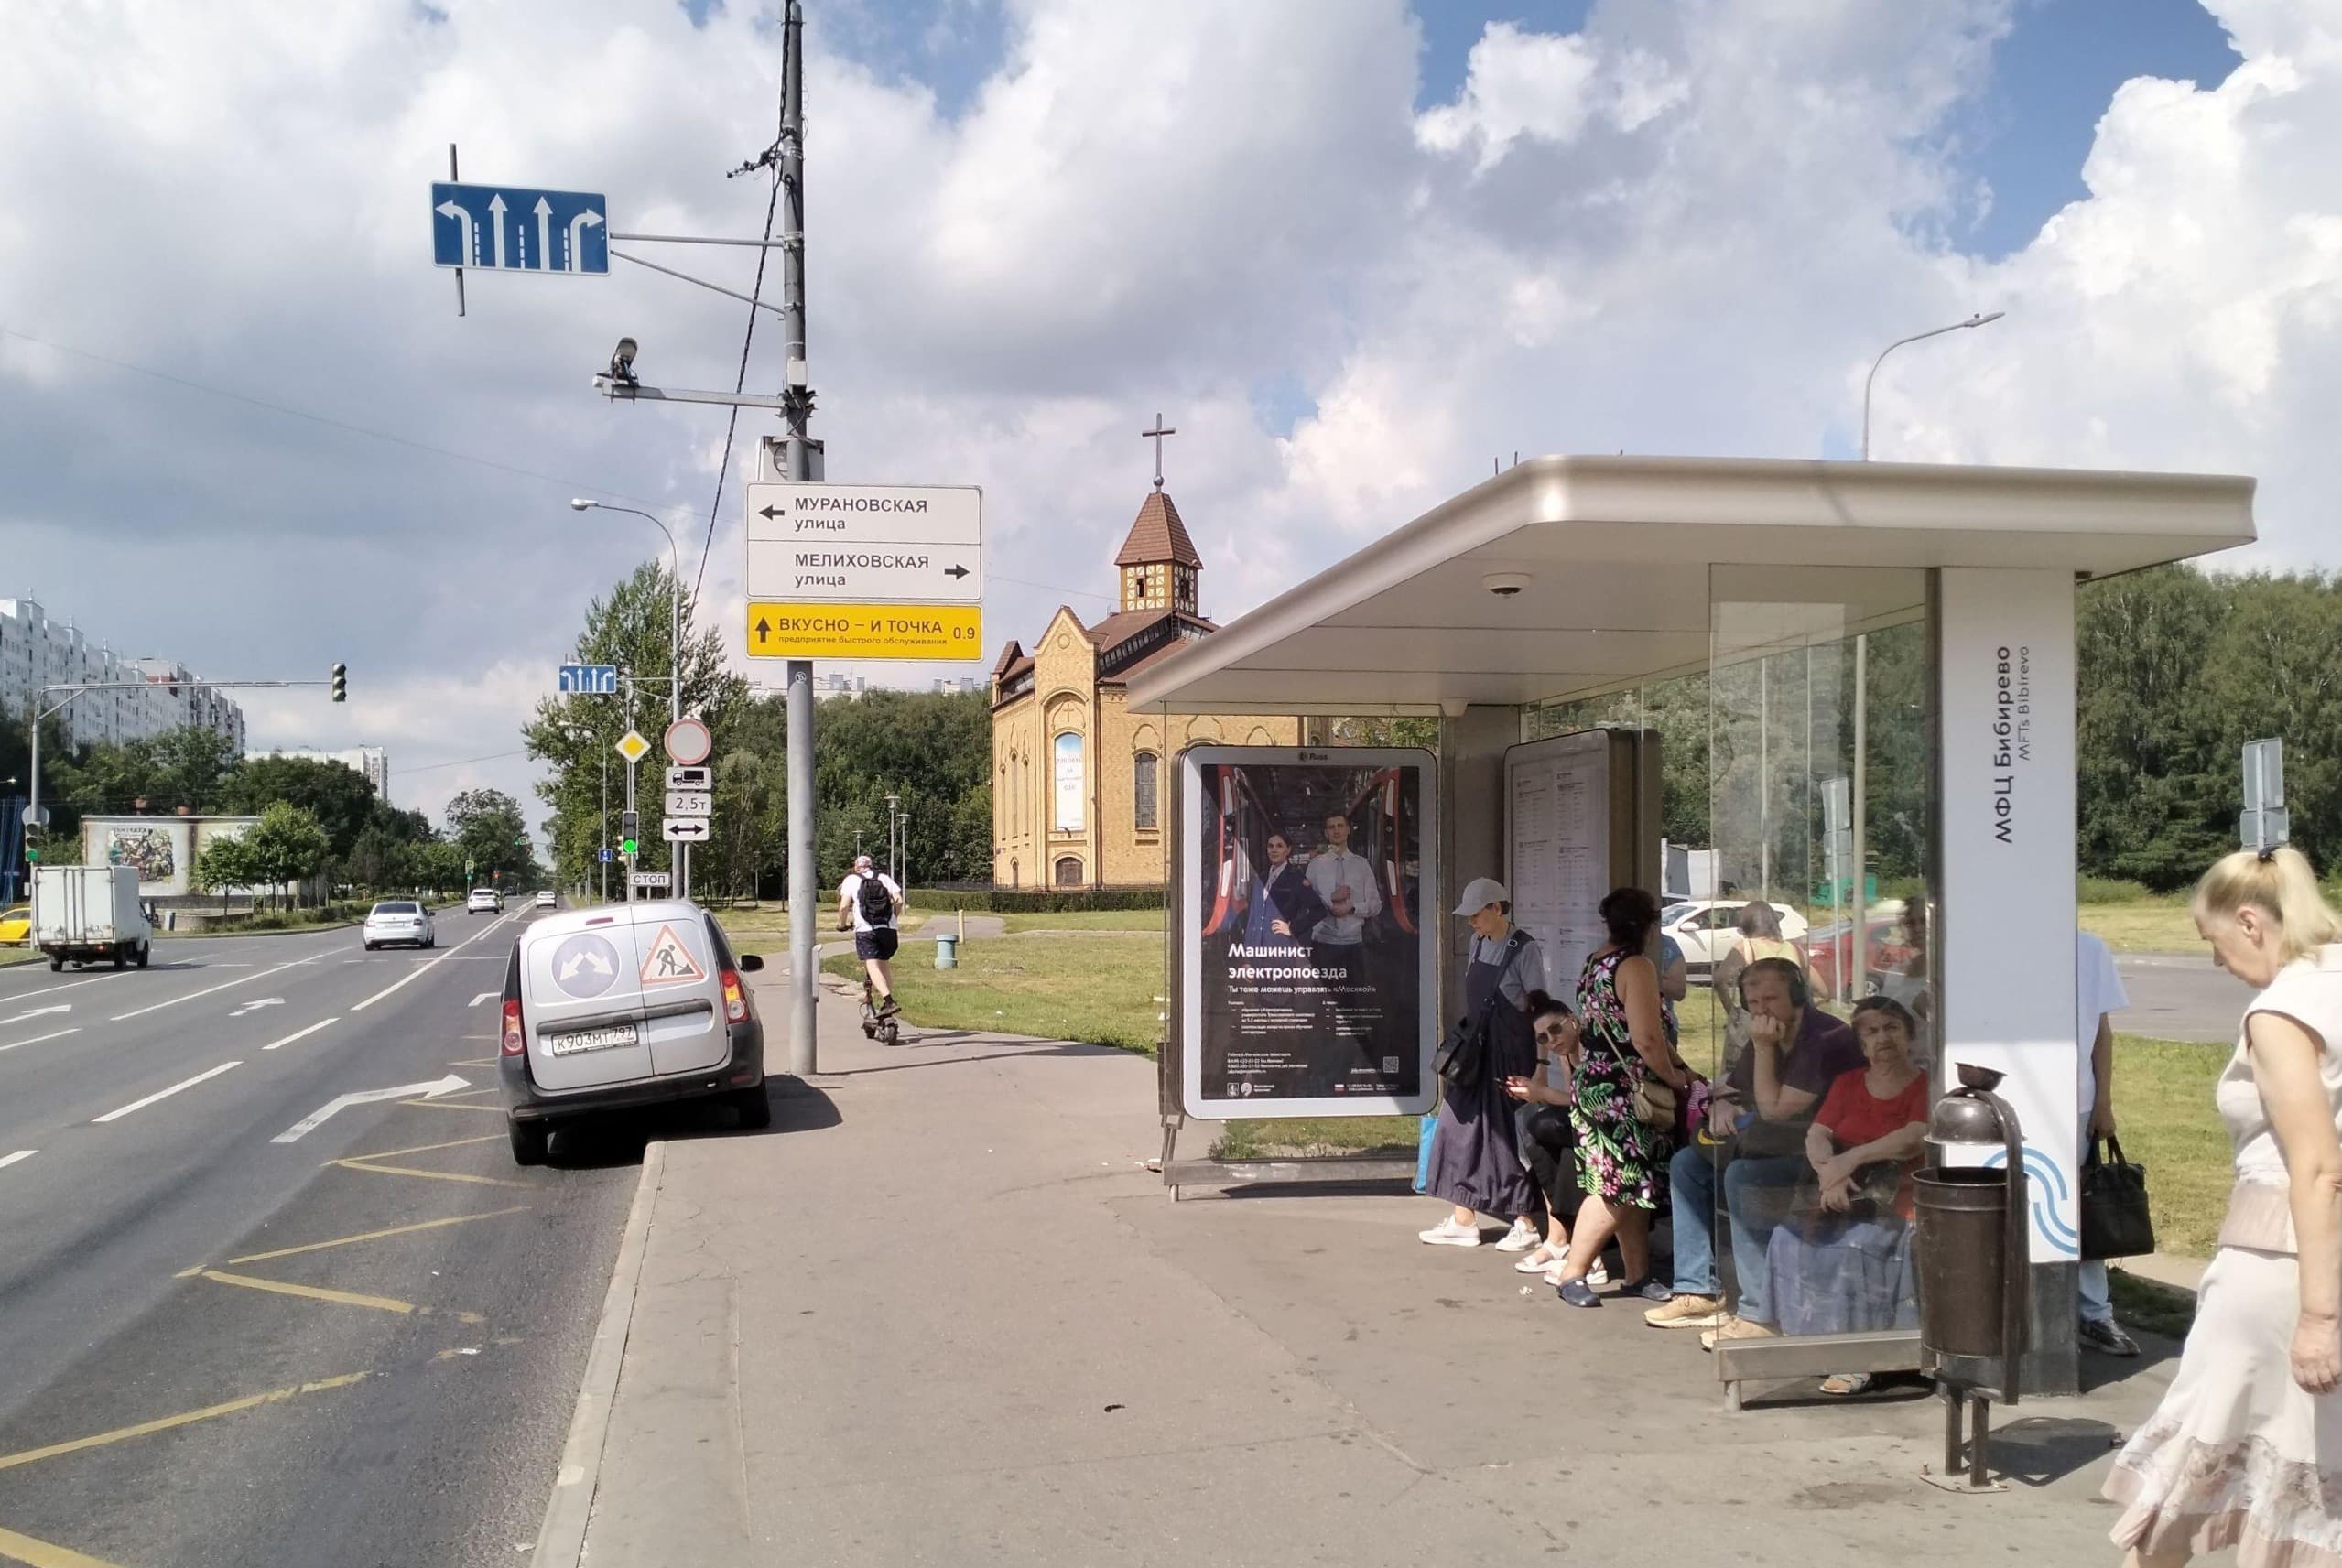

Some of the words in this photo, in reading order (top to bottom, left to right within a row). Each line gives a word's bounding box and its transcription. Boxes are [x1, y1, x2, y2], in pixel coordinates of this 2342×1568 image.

[795, 497, 927, 513] МУРАНОВСКАЯ
[795, 518, 846, 531] улица
[795, 554, 929, 568] МЕЛИХОВСКАЯ
[795, 575, 846, 588] улица
[779, 618, 850, 632] ВКУСНО
[871, 620, 882, 633] И
[887, 620, 943, 633] ТОЧКА
[778, 635, 836, 644] предприятие
[839, 636, 881, 645] быстрого
[884, 637, 948, 646] обслуживания
[953, 627, 975, 640] 0.9
[2018, 645, 2029, 715] Bibirevo
[1993, 645, 2014, 767] Бибирево
[2018, 719, 2030, 761] MFTs
[1994, 775, 2014, 844] МФЦ
[633, 874, 667, 885] СТОП
[1228, 943, 1313, 957] Машинист
[1228, 967, 1348, 980] электропоезда
[1228, 985, 1238, 993] Ты
